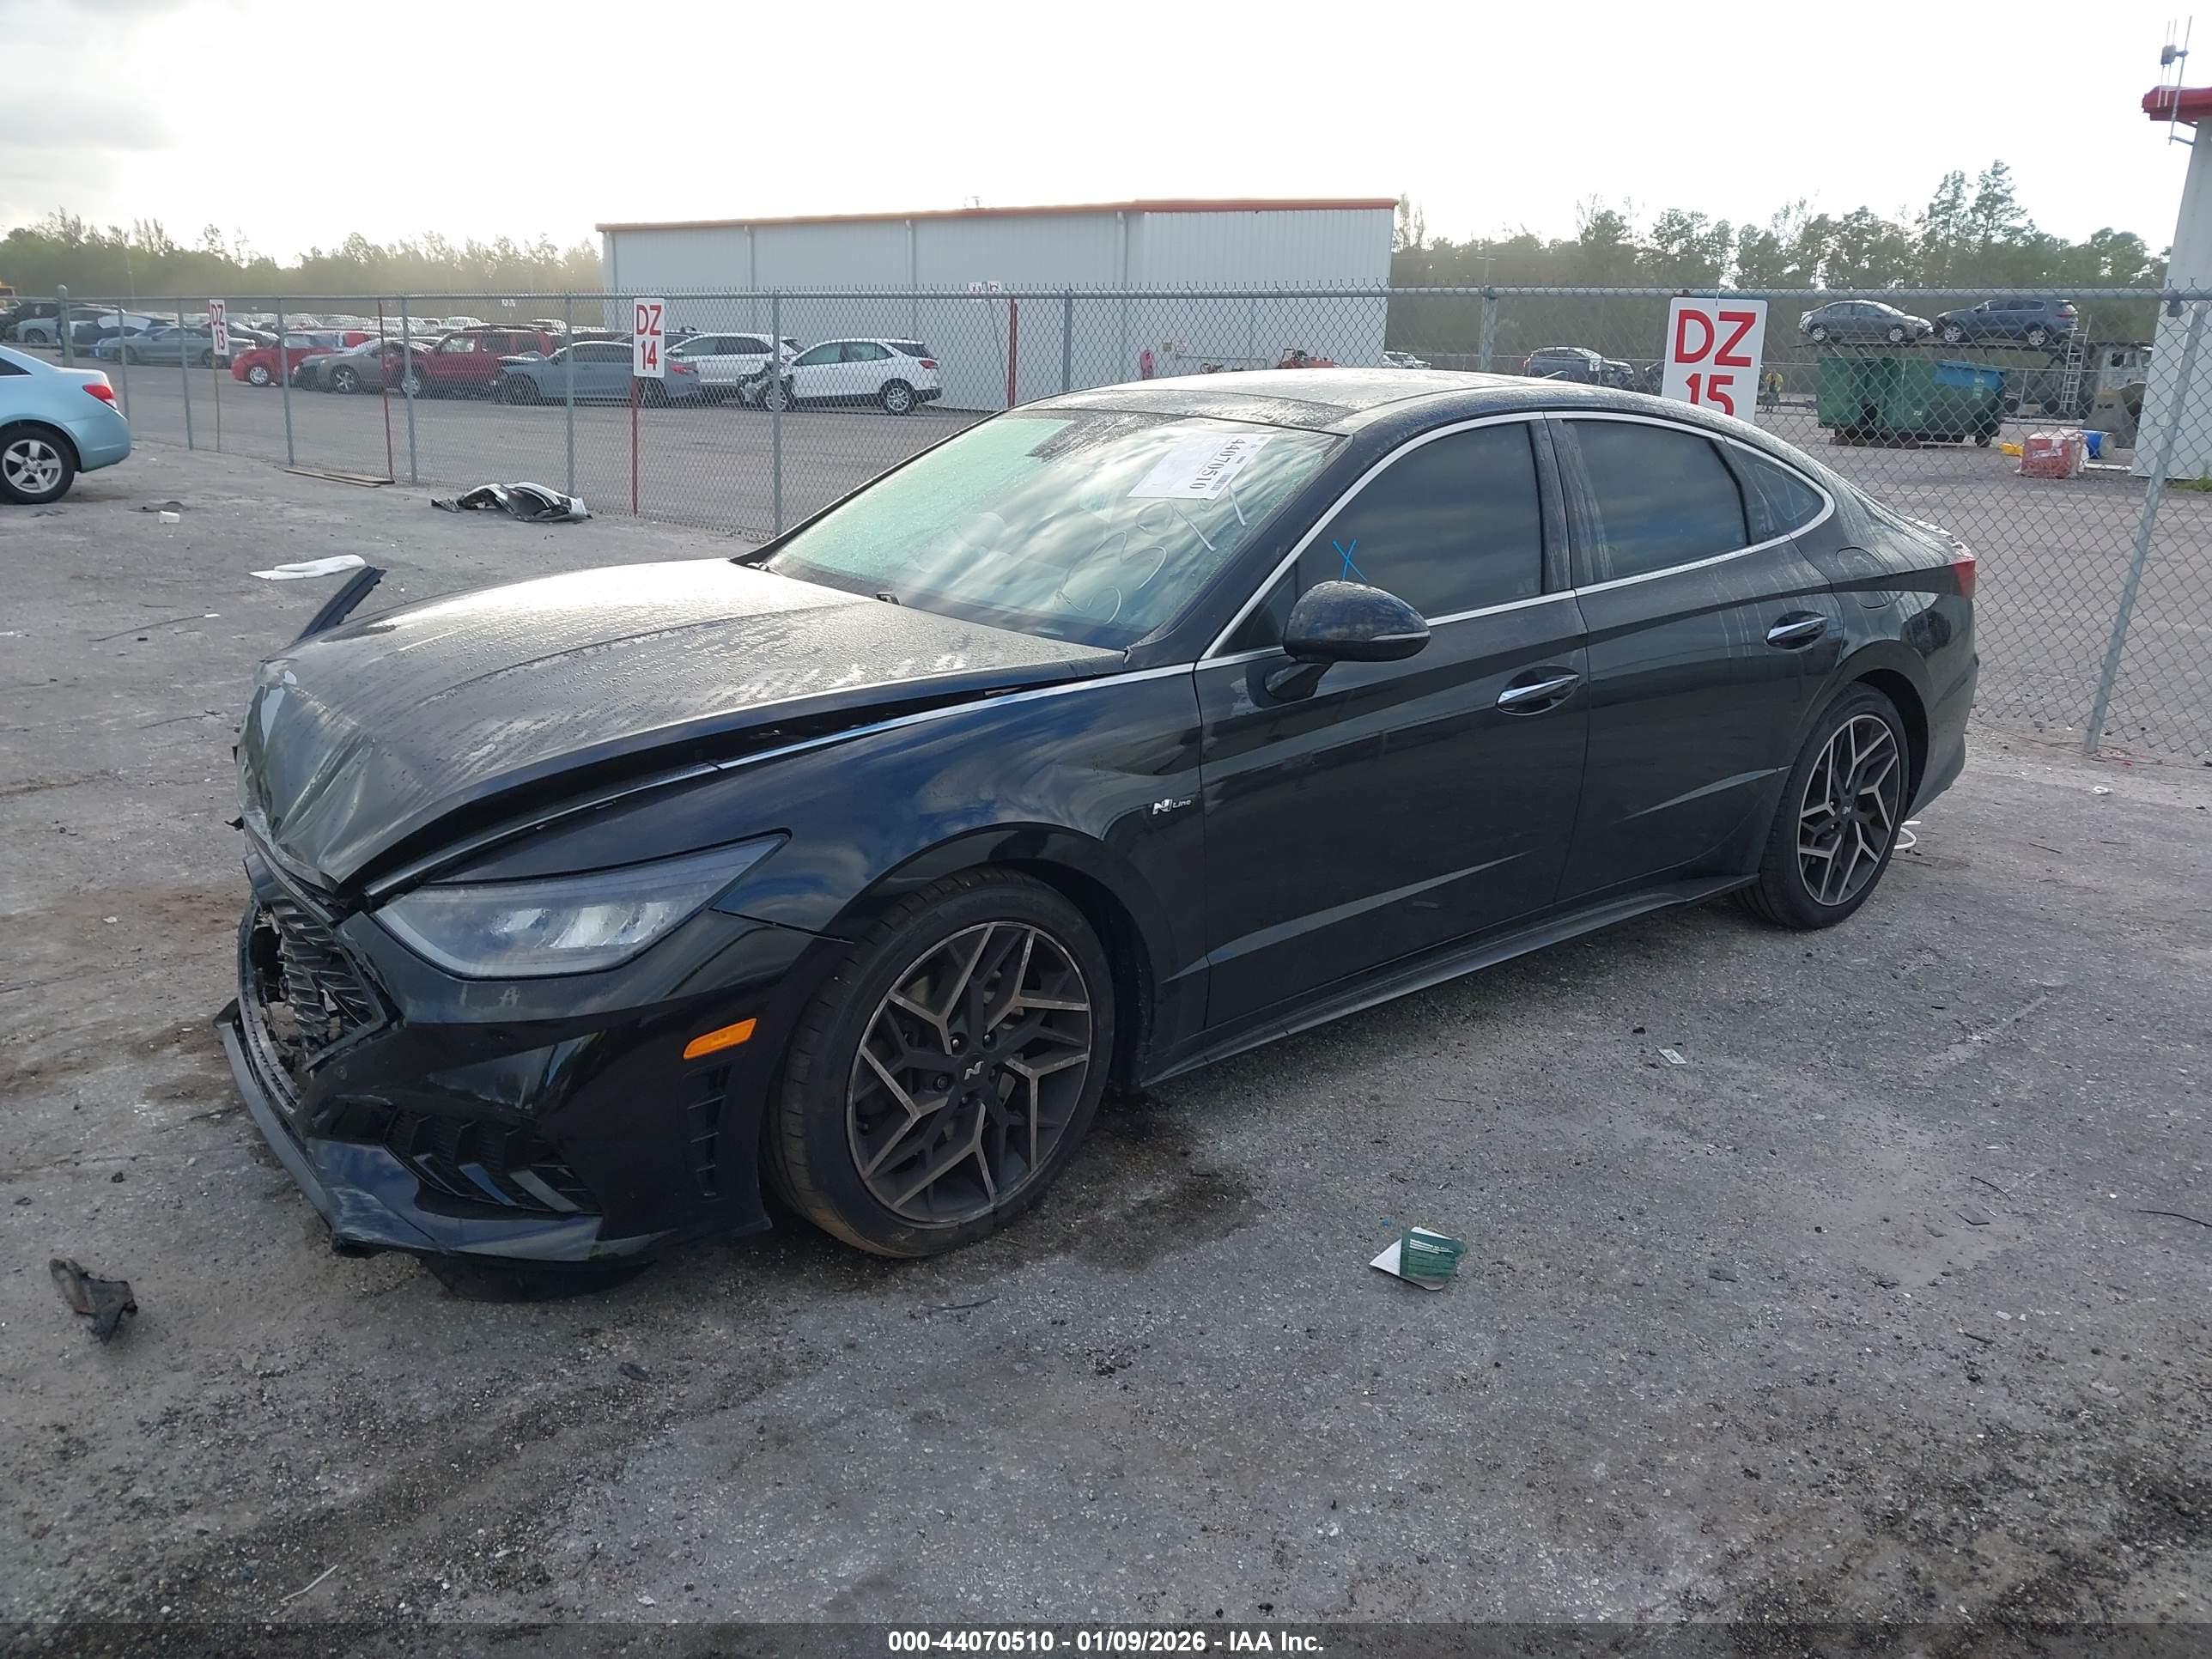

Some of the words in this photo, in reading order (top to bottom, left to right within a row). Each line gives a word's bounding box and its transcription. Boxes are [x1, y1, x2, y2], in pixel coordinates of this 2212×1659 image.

[211, 304, 225, 326] DZ
[636, 304, 662, 336] DZ
[216, 329, 226, 350] 13
[1674, 309, 1756, 368] DZ
[641, 340, 658, 371] 14
[1685, 373, 1735, 416] 15
[1188, 438, 1246, 489] 44070510
